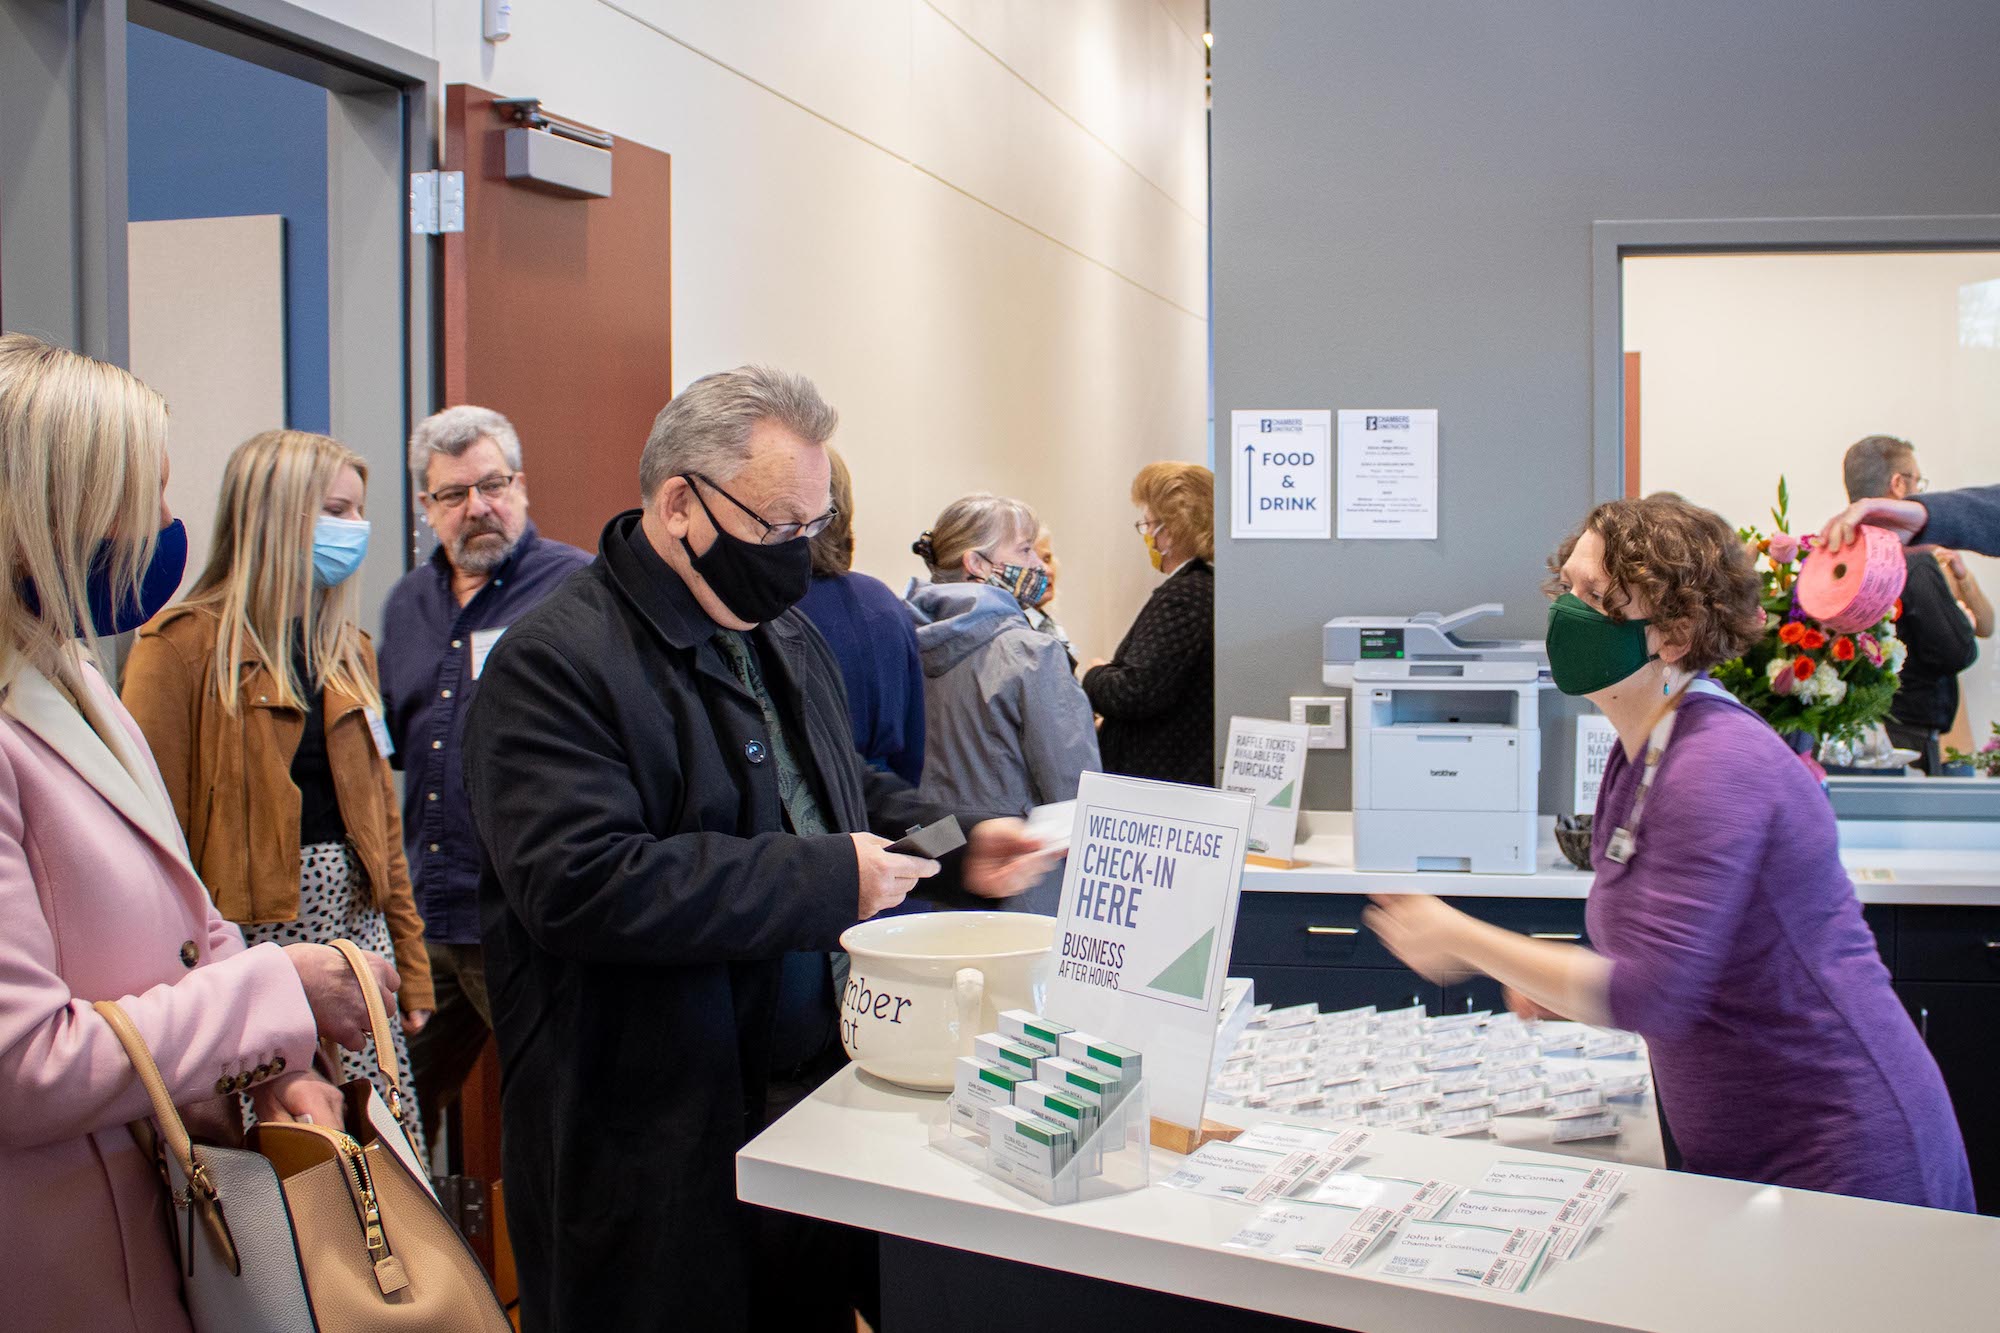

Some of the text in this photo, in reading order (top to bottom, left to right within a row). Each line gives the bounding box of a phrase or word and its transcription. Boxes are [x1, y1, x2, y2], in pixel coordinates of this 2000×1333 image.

[1263, 453, 1315, 466] FOOD
[1282, 475, 1295, 488] &
[1260, 498, 1317, 511] DRINK
[1236, 735, 1296, 752] RAFFLE TICKETS
[1587, 732, 1615, 743] PLEA
[1233, 748, 1286, 764] AVAILABLE FOR
[1232, 760, 1284, 781] PURCHASE
[1430, 769, 1458, 777] brother
[1089, 815, 1223, 859] WELCOME! PLEASE
[1083, 843, 1177, 890] CHECK-IN
[1075, 877, 1142, 930] HERE
[1062, 932, 1126, 969] BUSINESS
[1058, 959, 1119, 991] AFTER HOURS
[843, 977, 912, 1024] mber
[842, 1018, 858, 1050] ot
[1509, 1173, 1564, 1184] McCormack
[1459, 1202, 1548, 1216] Randi Staudinger
[1283, 1212, 1306, 1222] Levy
[1405, 1233, 1430, 1241] John
[1401, 1240, 1499, 1255] Chambers Construction
[1393, 1255, 1431, 1264] BUSINESS
